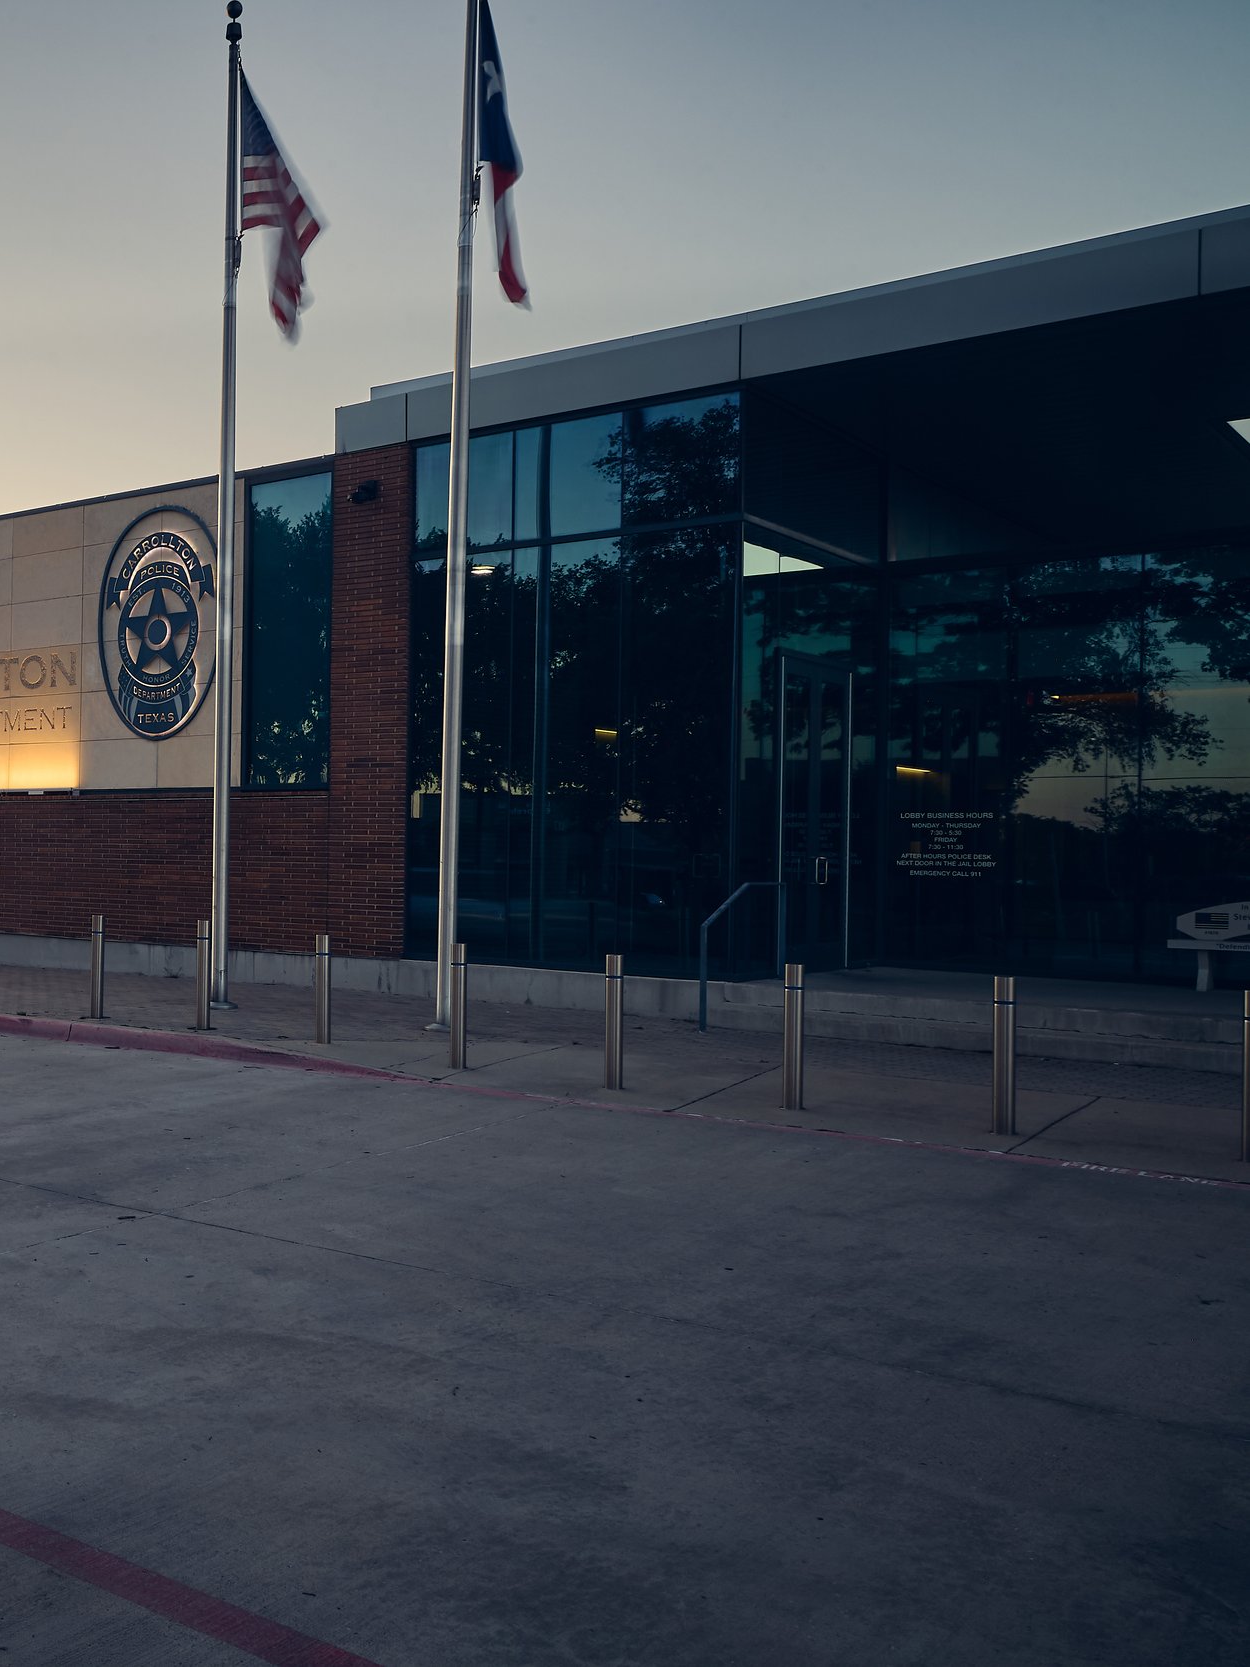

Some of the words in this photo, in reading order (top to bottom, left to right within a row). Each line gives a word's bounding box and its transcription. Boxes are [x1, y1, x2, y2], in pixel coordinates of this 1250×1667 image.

[122, 534, 197, 579] CARROLLTON
[140, 564, 180, 580] POLICE
[127, 587, 146, 607] EST.
[171, 582, 191, 603] 1913
[120, 633, 132, 667] TRUTH
[181, 620, 197, 665] SERVICE
[142, 673, 171, 683] HONOR
[133, 682, 181, 700] DEPARTMENT
[137, 712, 175, 724] TEXAS
[1061, 1161, 1130, 1175] FIRE
[1138, 1171, 1219, 1186] LANE
